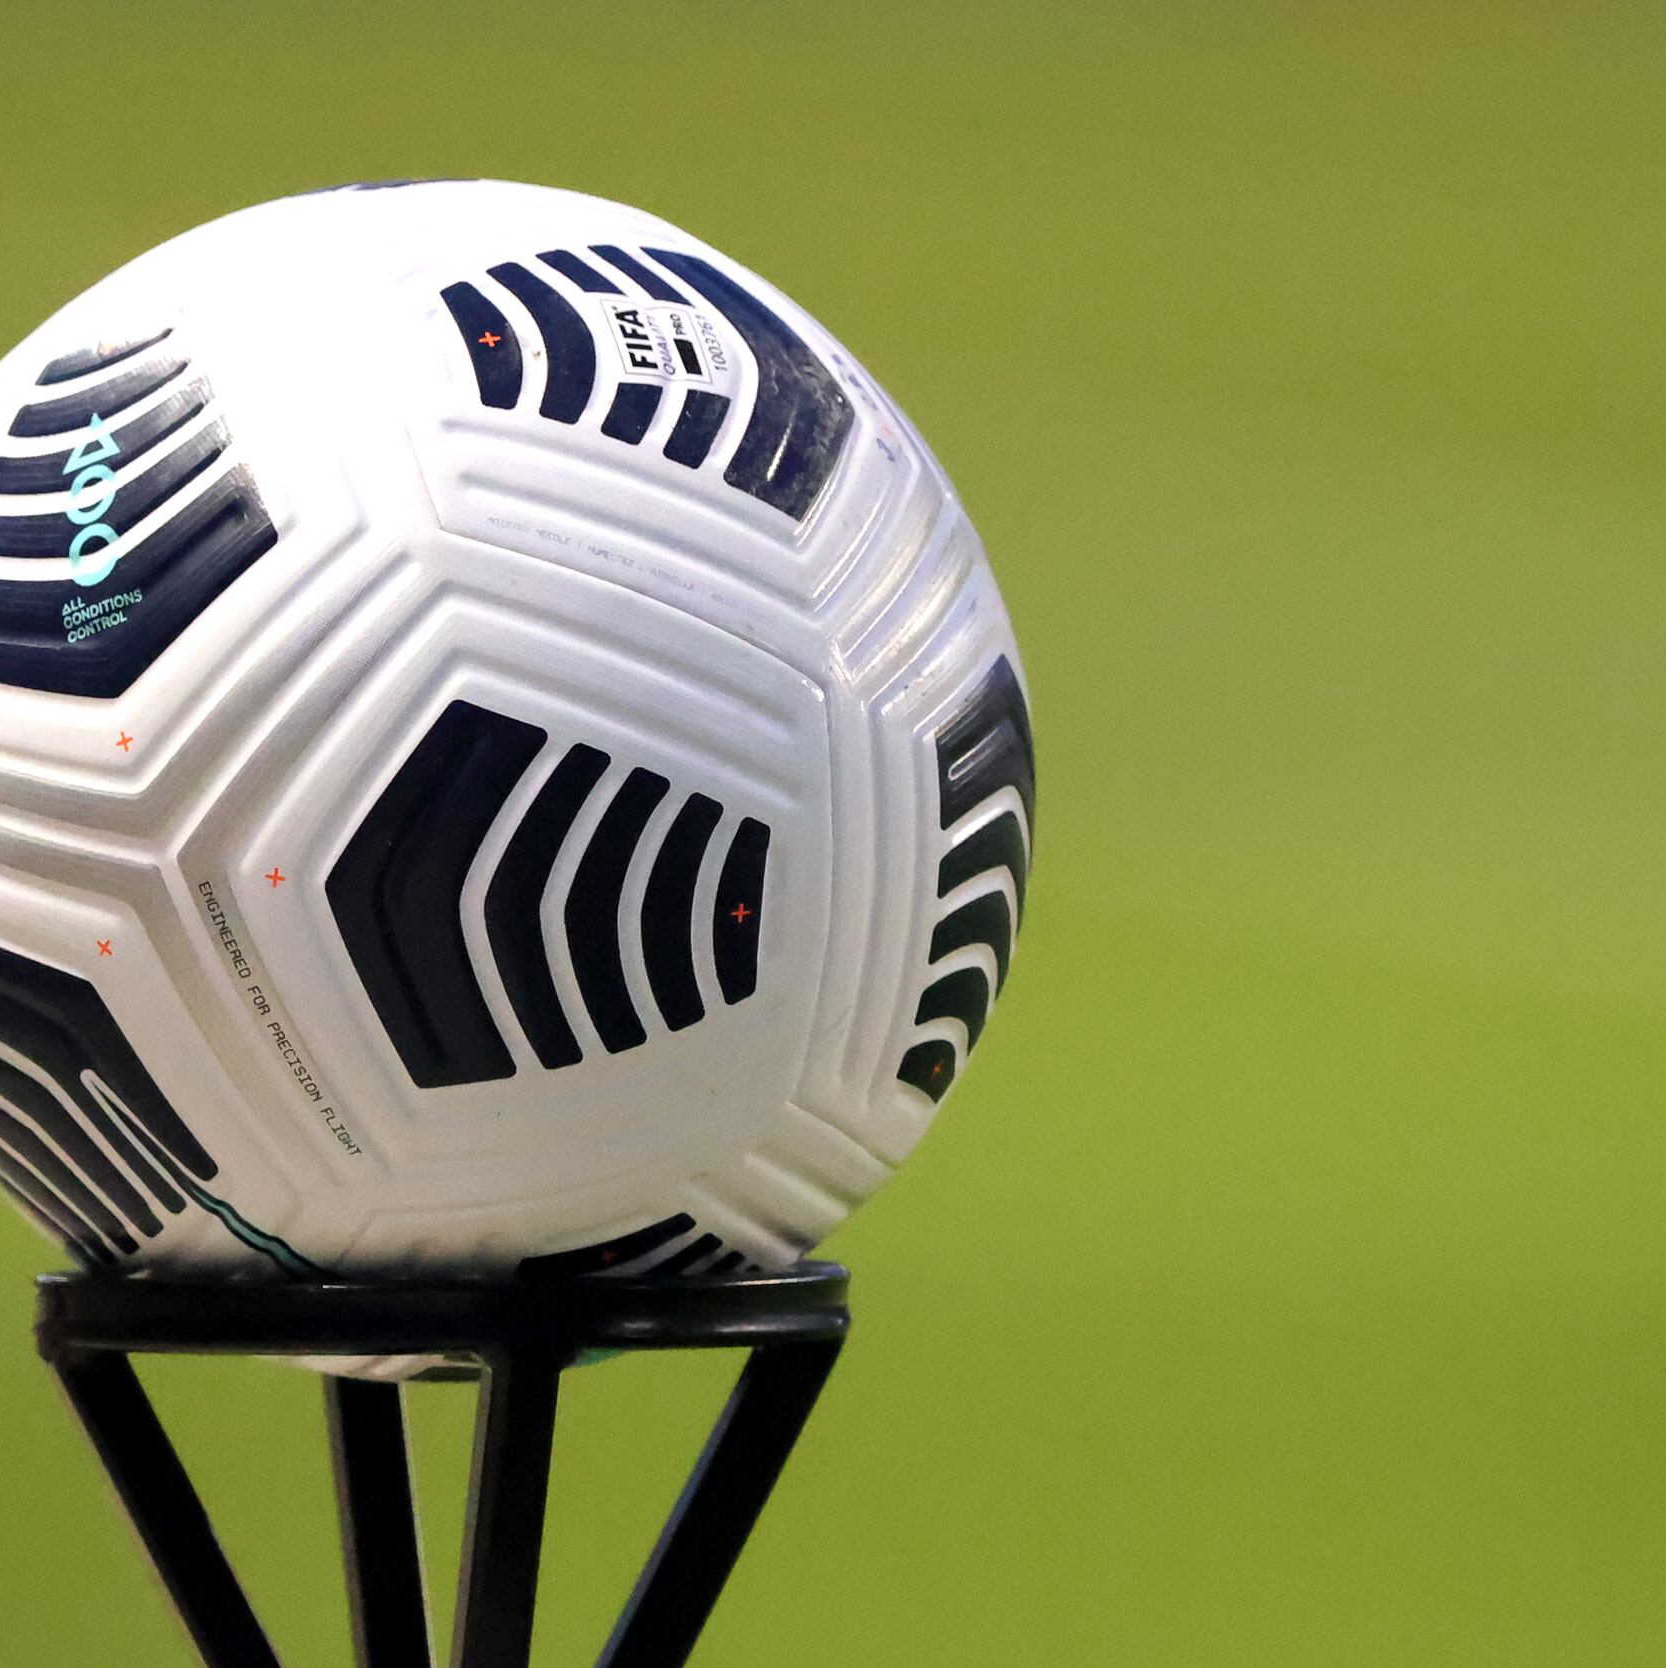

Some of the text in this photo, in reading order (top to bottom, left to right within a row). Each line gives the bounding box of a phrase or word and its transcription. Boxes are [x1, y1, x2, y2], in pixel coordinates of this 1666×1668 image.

[614, 308, 659, 370] FIFA
[670, 313, 687, 336] PRO
[646, 315, 676, 376] QUALITY
[62, 596, 86, 616] ALL
[65, 588, 143, 629] CONDITIONS
[67, 611, 128, 643] CONTROL
[199, 881, 362, 1156] ENGINEERED FOR PRECISION FLIGHT
